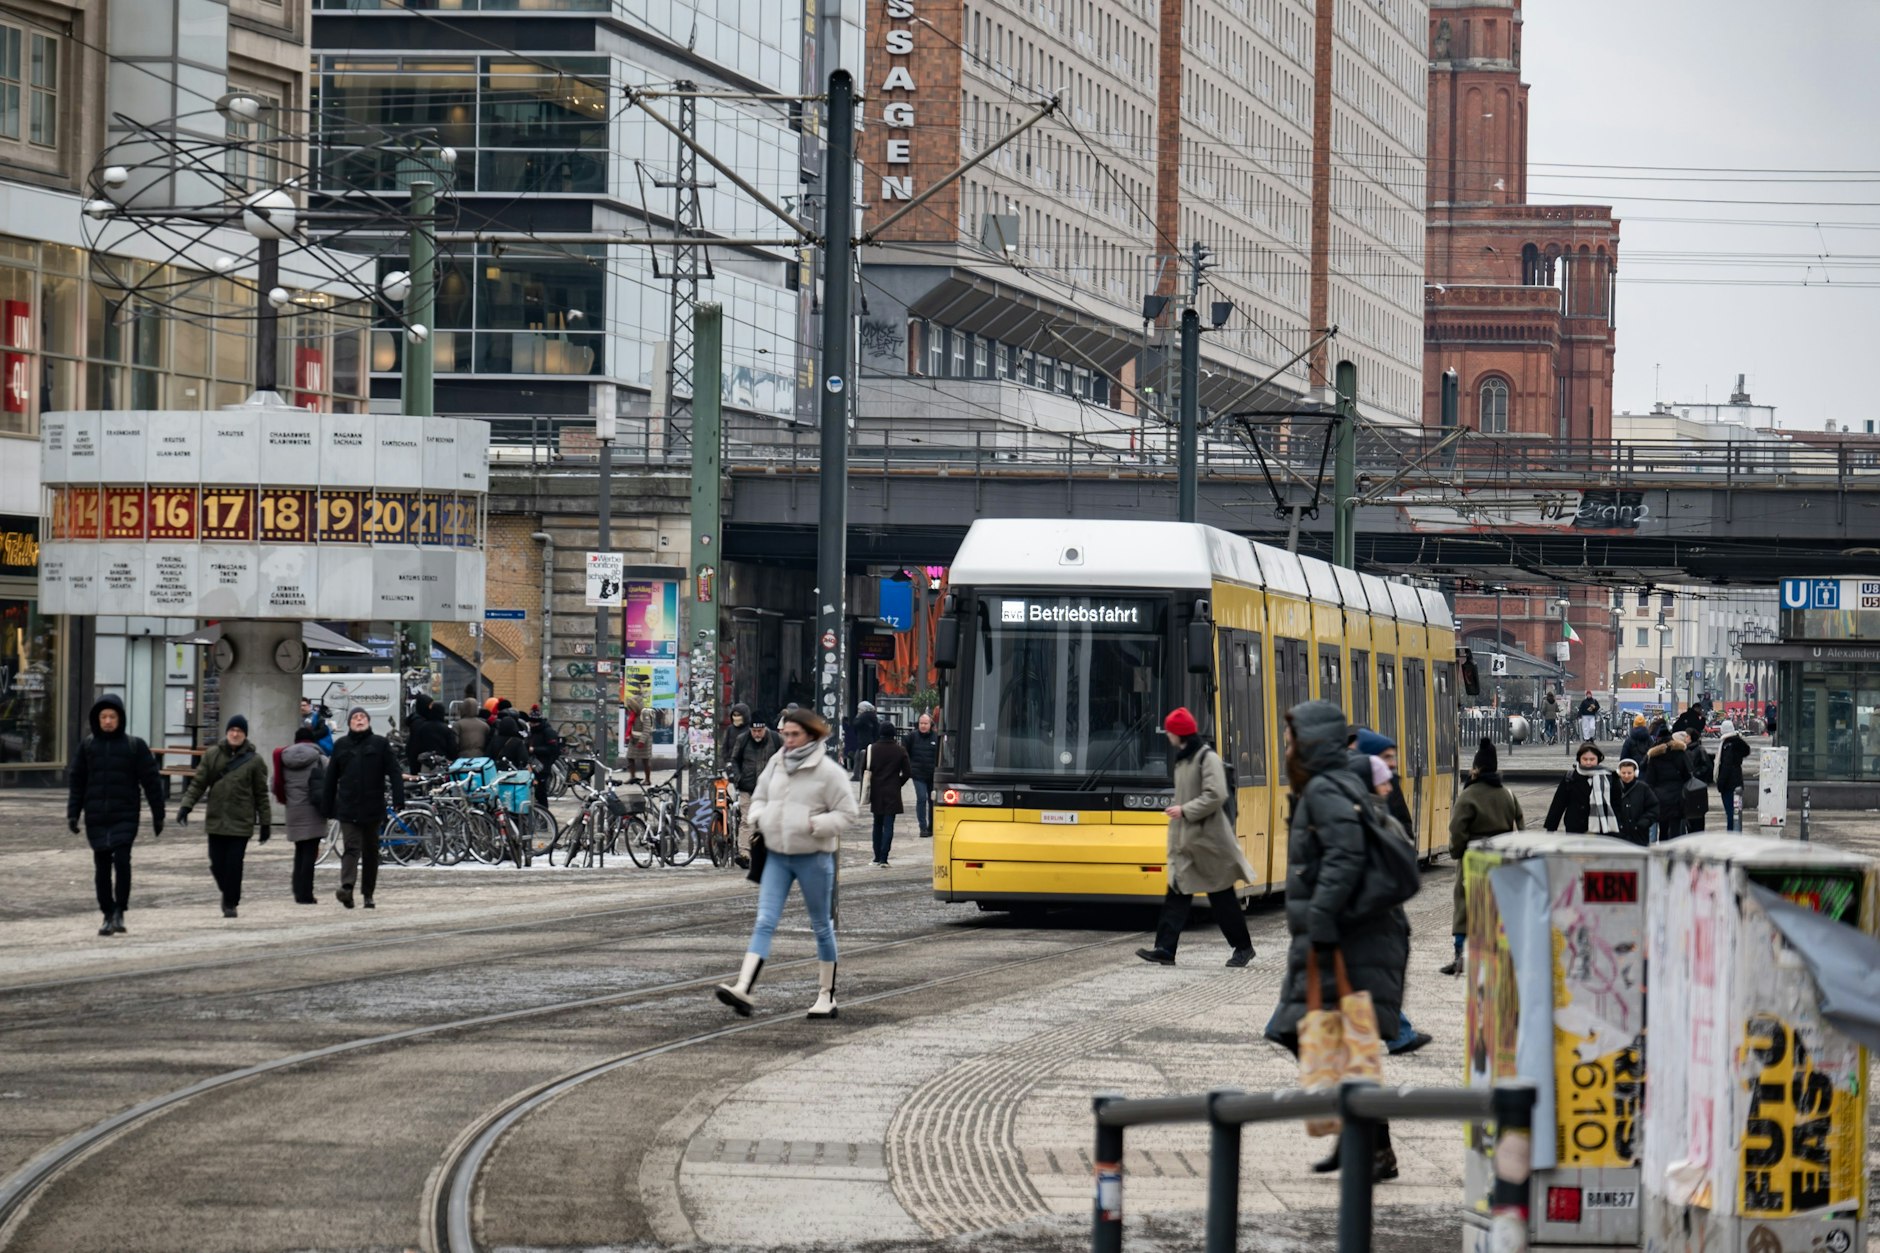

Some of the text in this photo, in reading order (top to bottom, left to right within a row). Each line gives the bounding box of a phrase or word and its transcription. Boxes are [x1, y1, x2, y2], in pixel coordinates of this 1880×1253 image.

[76, 496, 98, 527] 14
[109, 496, 139, 527] 15
[151, 495, 189, 528] 16
[203, 496, 245, 529] 17
[261, 497, 300, 530] 18
[315, 499, 354, 531] 19
[363, 501, 405, 534] 20
[410, 502, 437, 533] 21
[444, 503, 465, 535] 22
[1785, 581, 1807, 607] U
[1863, 584, 1880, 593] U8
[1863, 598, 1880, 606] U5
[1029, 605, 1138, 622] Betriebsfahrt
[1813, 648, 1821, 657] U
